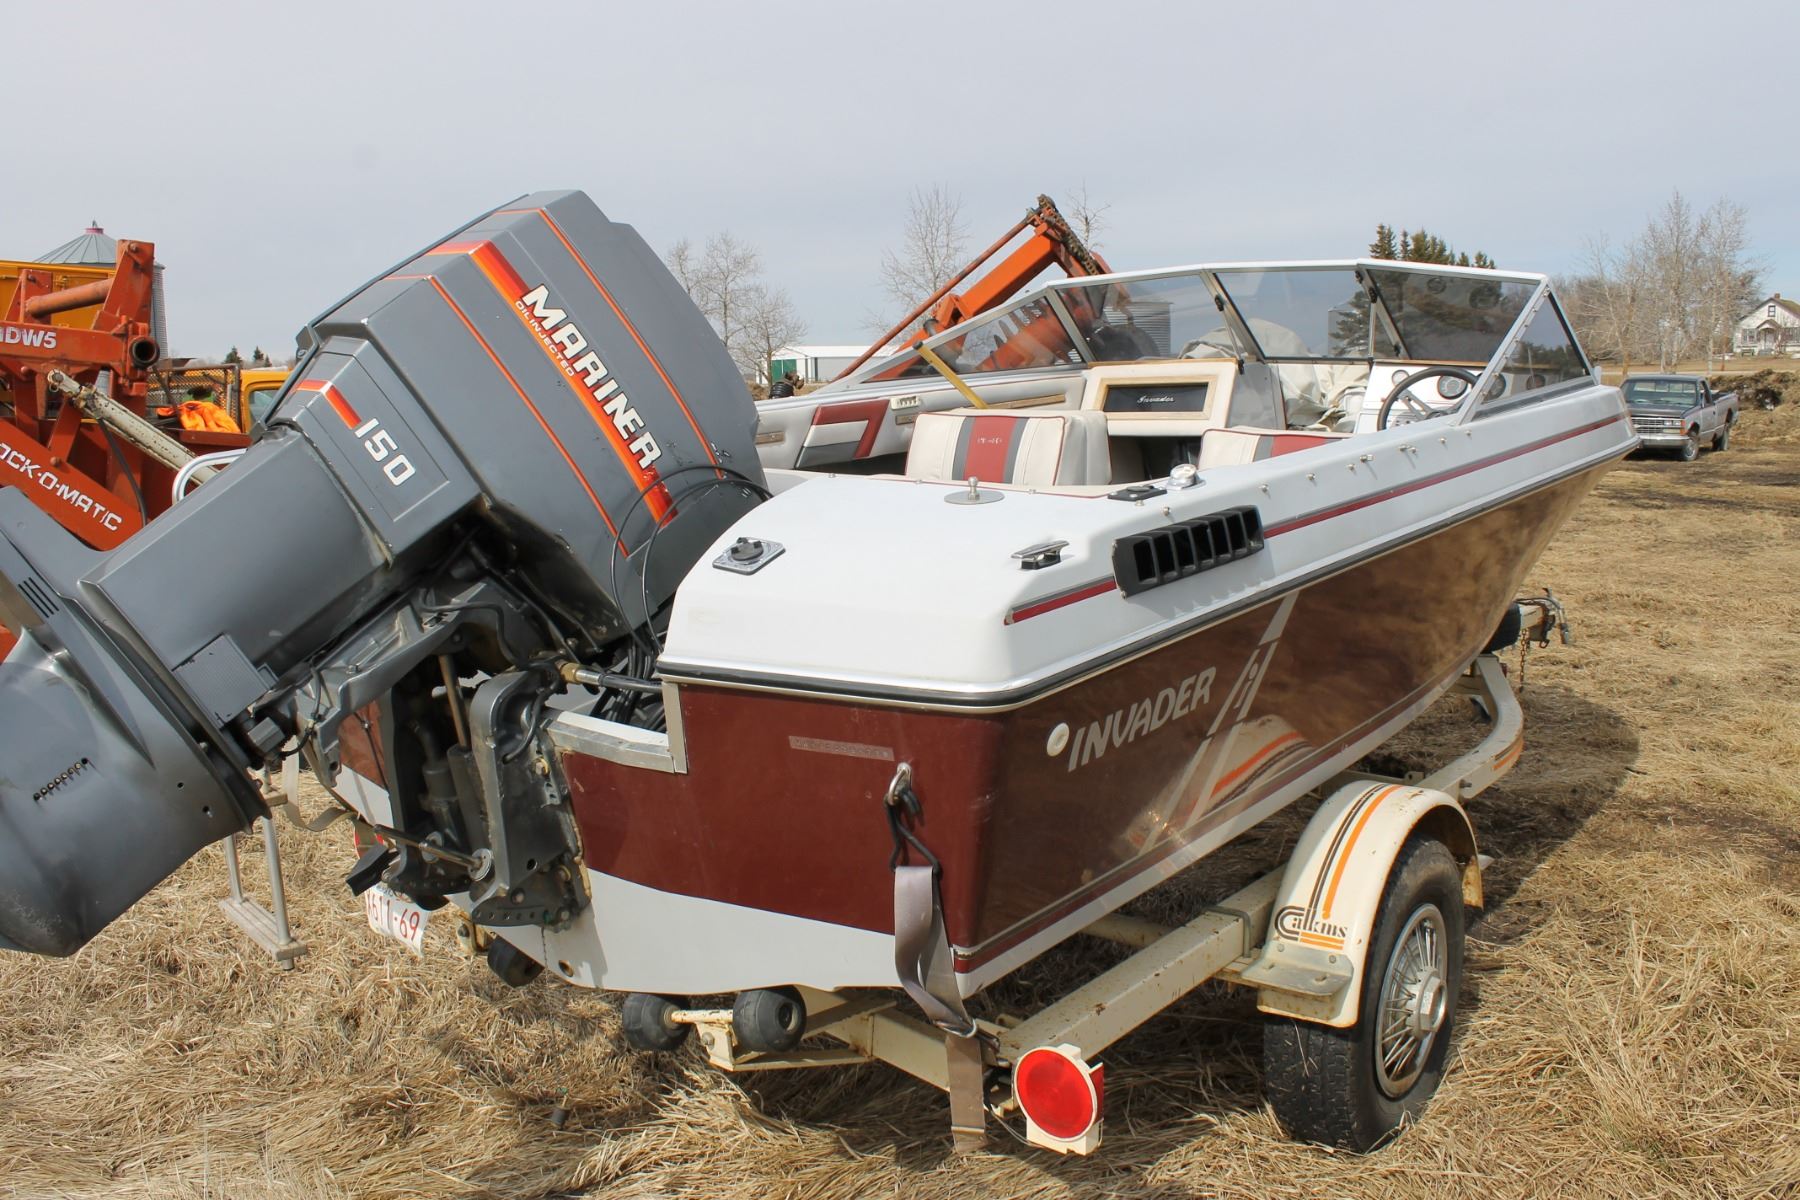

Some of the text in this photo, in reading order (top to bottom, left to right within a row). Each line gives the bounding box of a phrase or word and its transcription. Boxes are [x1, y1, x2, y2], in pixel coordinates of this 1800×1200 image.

[0, 326, 57, 349] DW5
[515, 300, 575, 377] OIL INJECTED
[521, 284, 662, 470] MARINER
[354, 418, 416, 486] 150
[1067, 666, 1217, 773] INVADER
